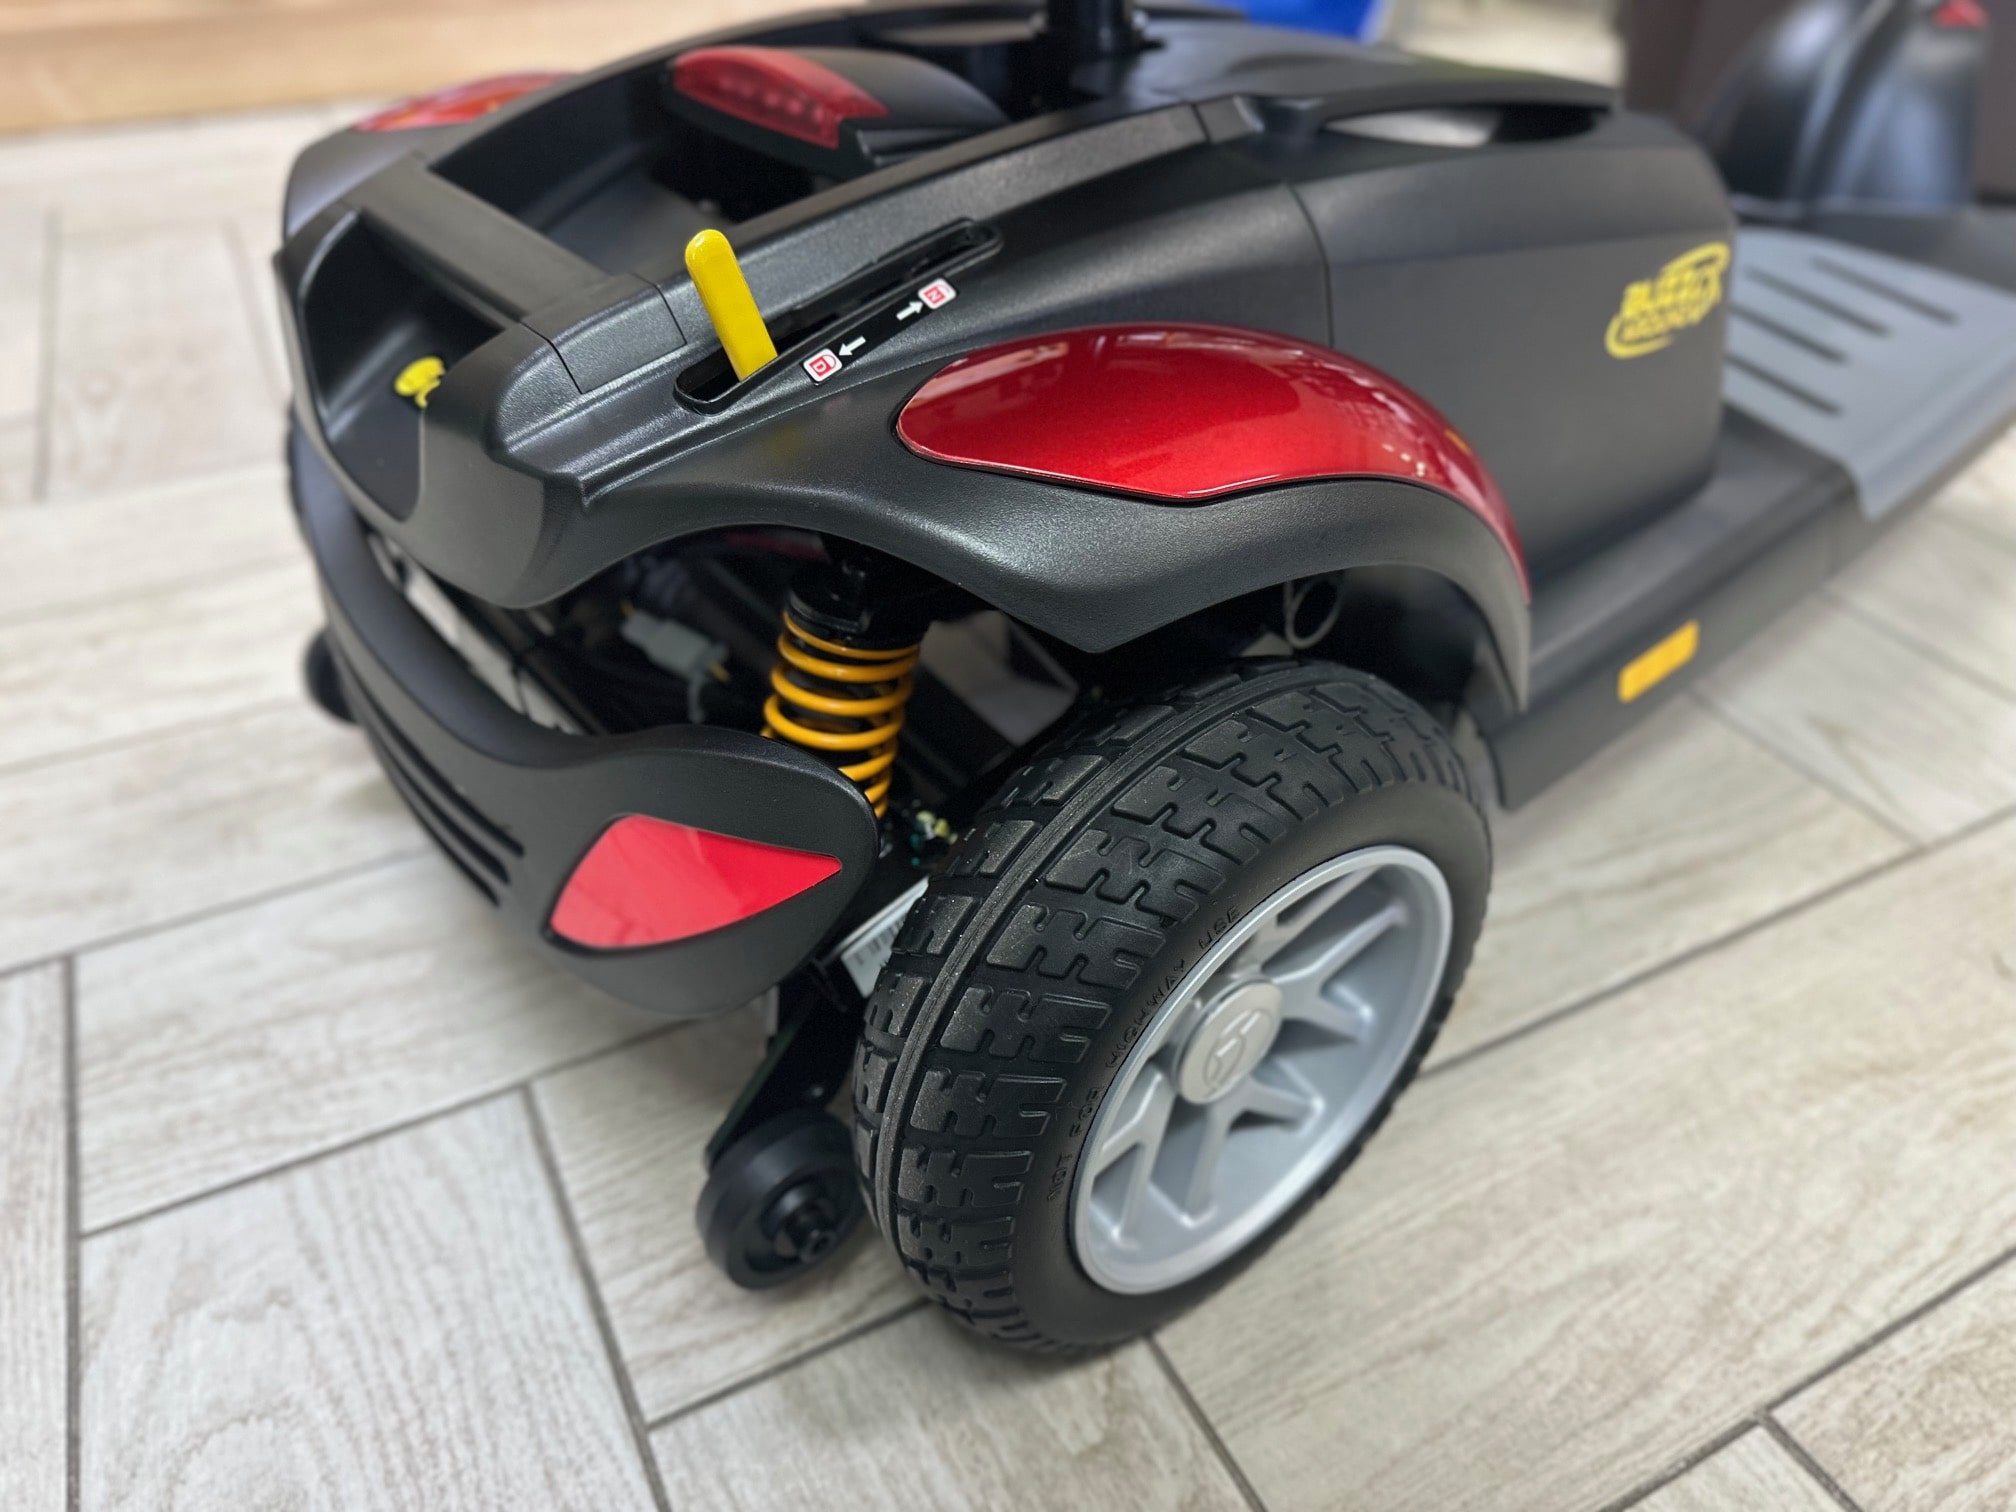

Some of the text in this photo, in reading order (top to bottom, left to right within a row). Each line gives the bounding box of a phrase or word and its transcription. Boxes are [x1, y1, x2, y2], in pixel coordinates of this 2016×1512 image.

[1047, 905, 1240, 1200] NOT FOR HIGHWAY USE
